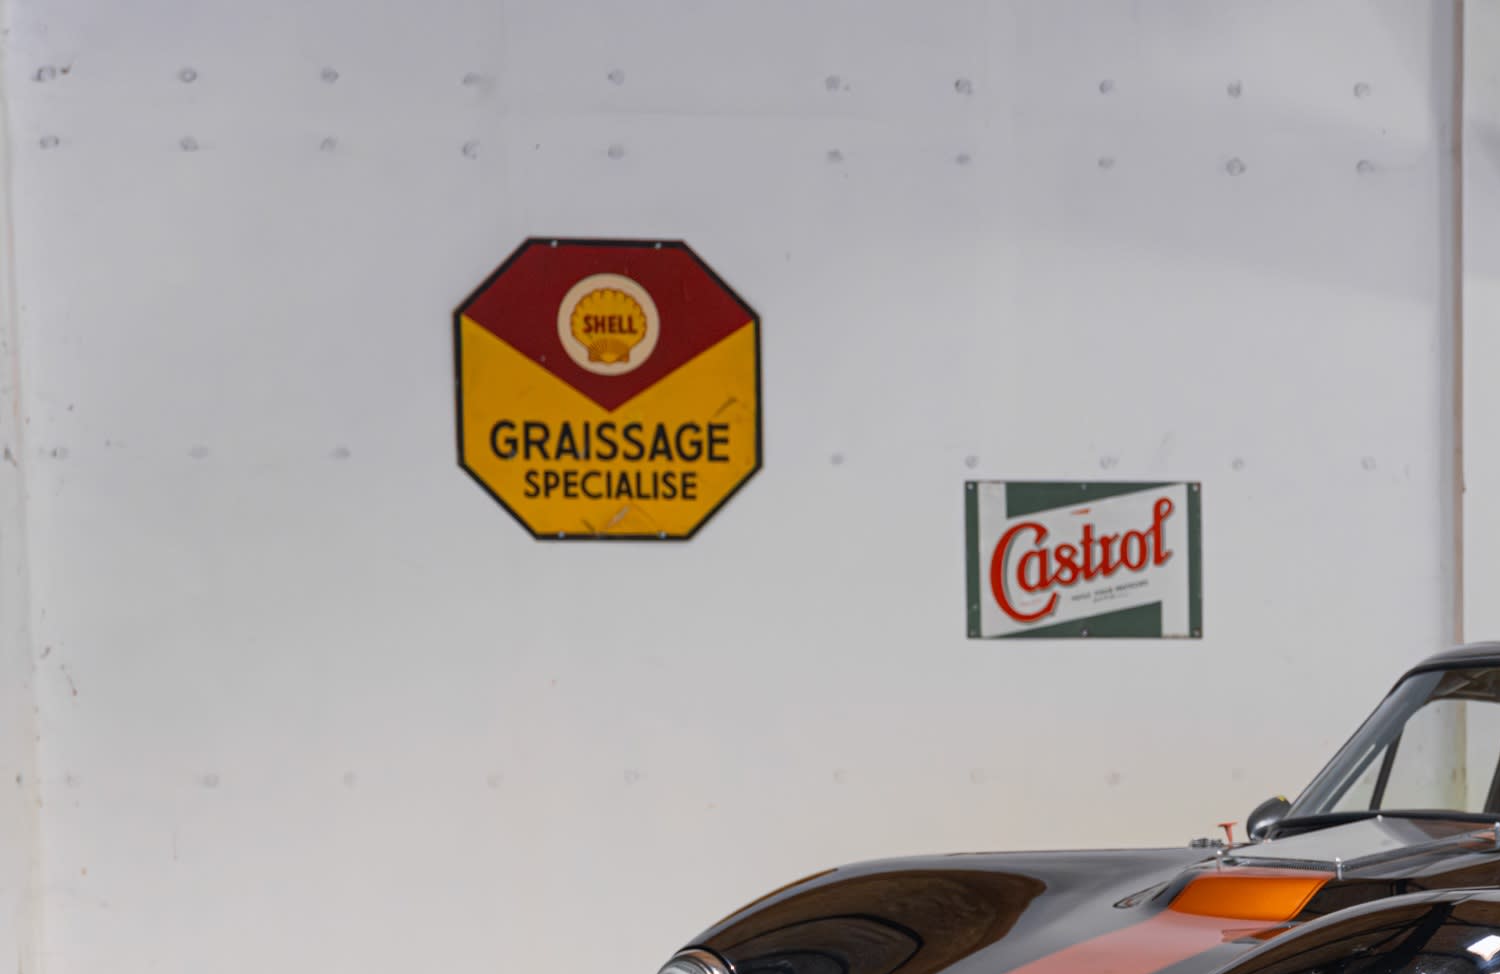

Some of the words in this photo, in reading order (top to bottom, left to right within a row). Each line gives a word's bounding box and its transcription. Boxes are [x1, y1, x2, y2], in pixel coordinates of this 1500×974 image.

[583, 314, 638, 335] SHELL
[489, 419, 730, 463] GRAISSAGE
[523, 470, 698, 500] SPECIALISE
[990, 496, 1174, 623] Castrol
